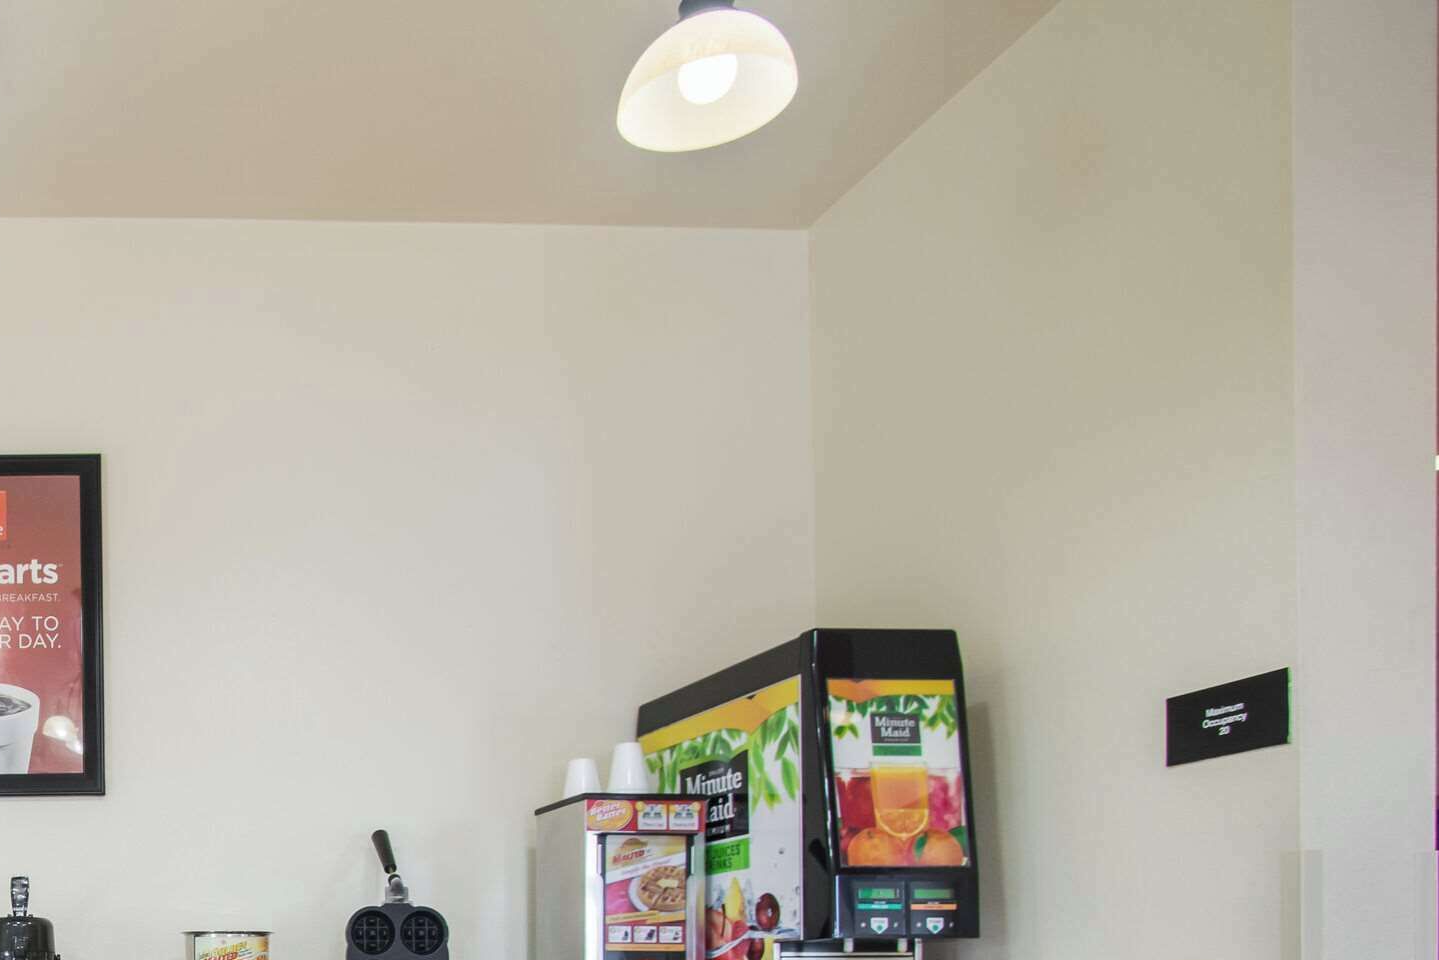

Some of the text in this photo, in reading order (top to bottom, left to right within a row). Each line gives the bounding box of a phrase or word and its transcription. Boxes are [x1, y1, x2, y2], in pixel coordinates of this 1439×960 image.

[31, 616, 60, 632] TO
[18, 633, 62, 649] DAY.
[1205, 702, 1245, 718] Maximum
[875, 716, 916, 727] Minute
[1201, 712, 1248, 729] Occupancy
[880, 727, 911, 737] Maid
[686, 767, 743, 795] Minute
[708, 793, 736, 822] aid
